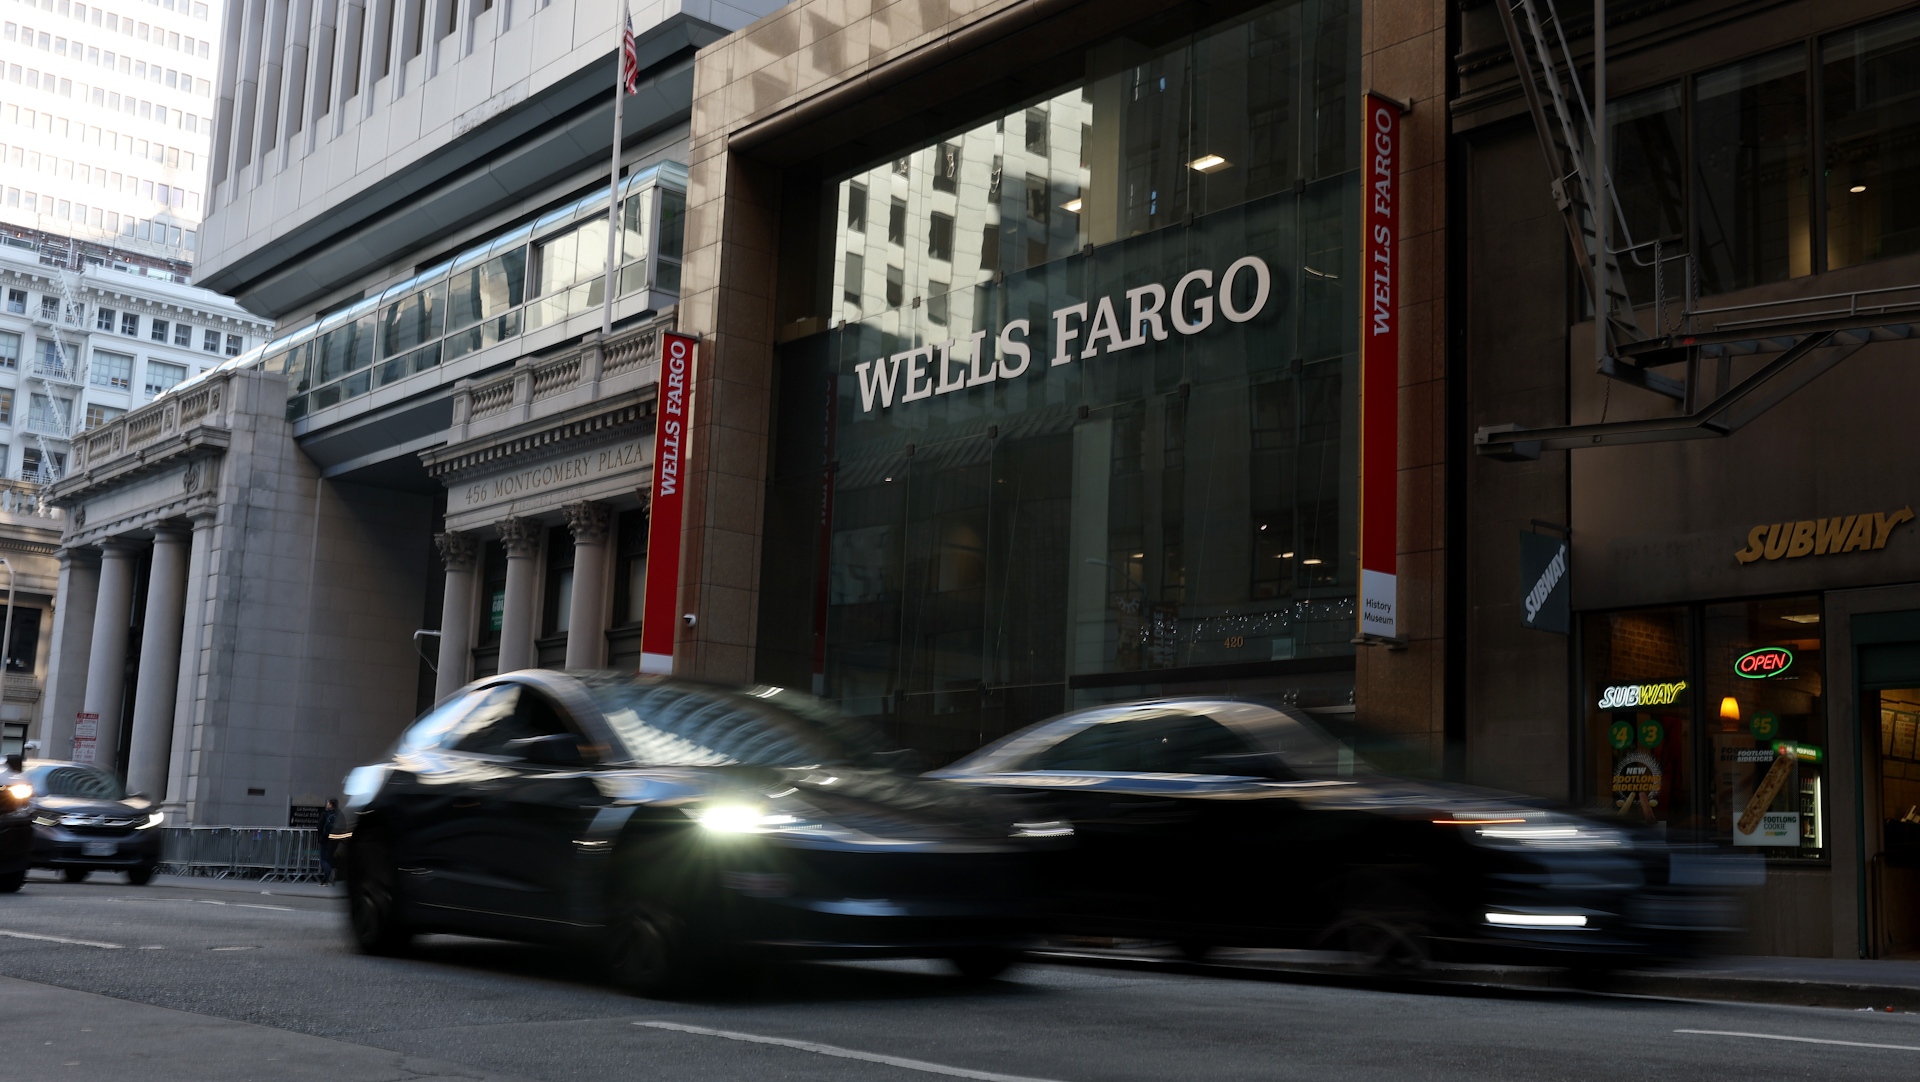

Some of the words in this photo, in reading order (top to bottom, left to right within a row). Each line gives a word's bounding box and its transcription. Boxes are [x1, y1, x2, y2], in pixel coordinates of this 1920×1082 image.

[1375, 107, 1393, 218] FARGO
[1374, 224, 1391, 336] WELLS
[854, 318, 1031, 413] WELLS
[1050, 255, 1271, 368] FARGO
[666, 341, 686, 417] FARGO
[660, 421, 681, 496] WELLS
[465, 483, 488, 505] 456
[493, 455, 592, 499] MONTGOMERY
[597, 442, 644, 473] PLAZA
[1735, 505, 1915, 566] SUBWAY
[1525, 543, 1566, 624] SUBWAY
[1366, 598, 1391, 613] History
[1364, 611, 1393, 625] Museum
[1224, 635, 1244, 649] 420
[1741, 652, 1786, 673] OPEN
[1598, 680, 1688, 710] SUBWAY
[1612, 726, 1629, 743] $4
[1641, 725, 1658, 742] $3
[1753, 717, 1772, 734] $5
[1612, 775, 1662, 784] FOOTLONG
[1625, 766, 1647, 776] NEW
[1612, 783, 1662, 792] SIDEKICKS
[1763, 815, 1797, 824] FOOTLONG
